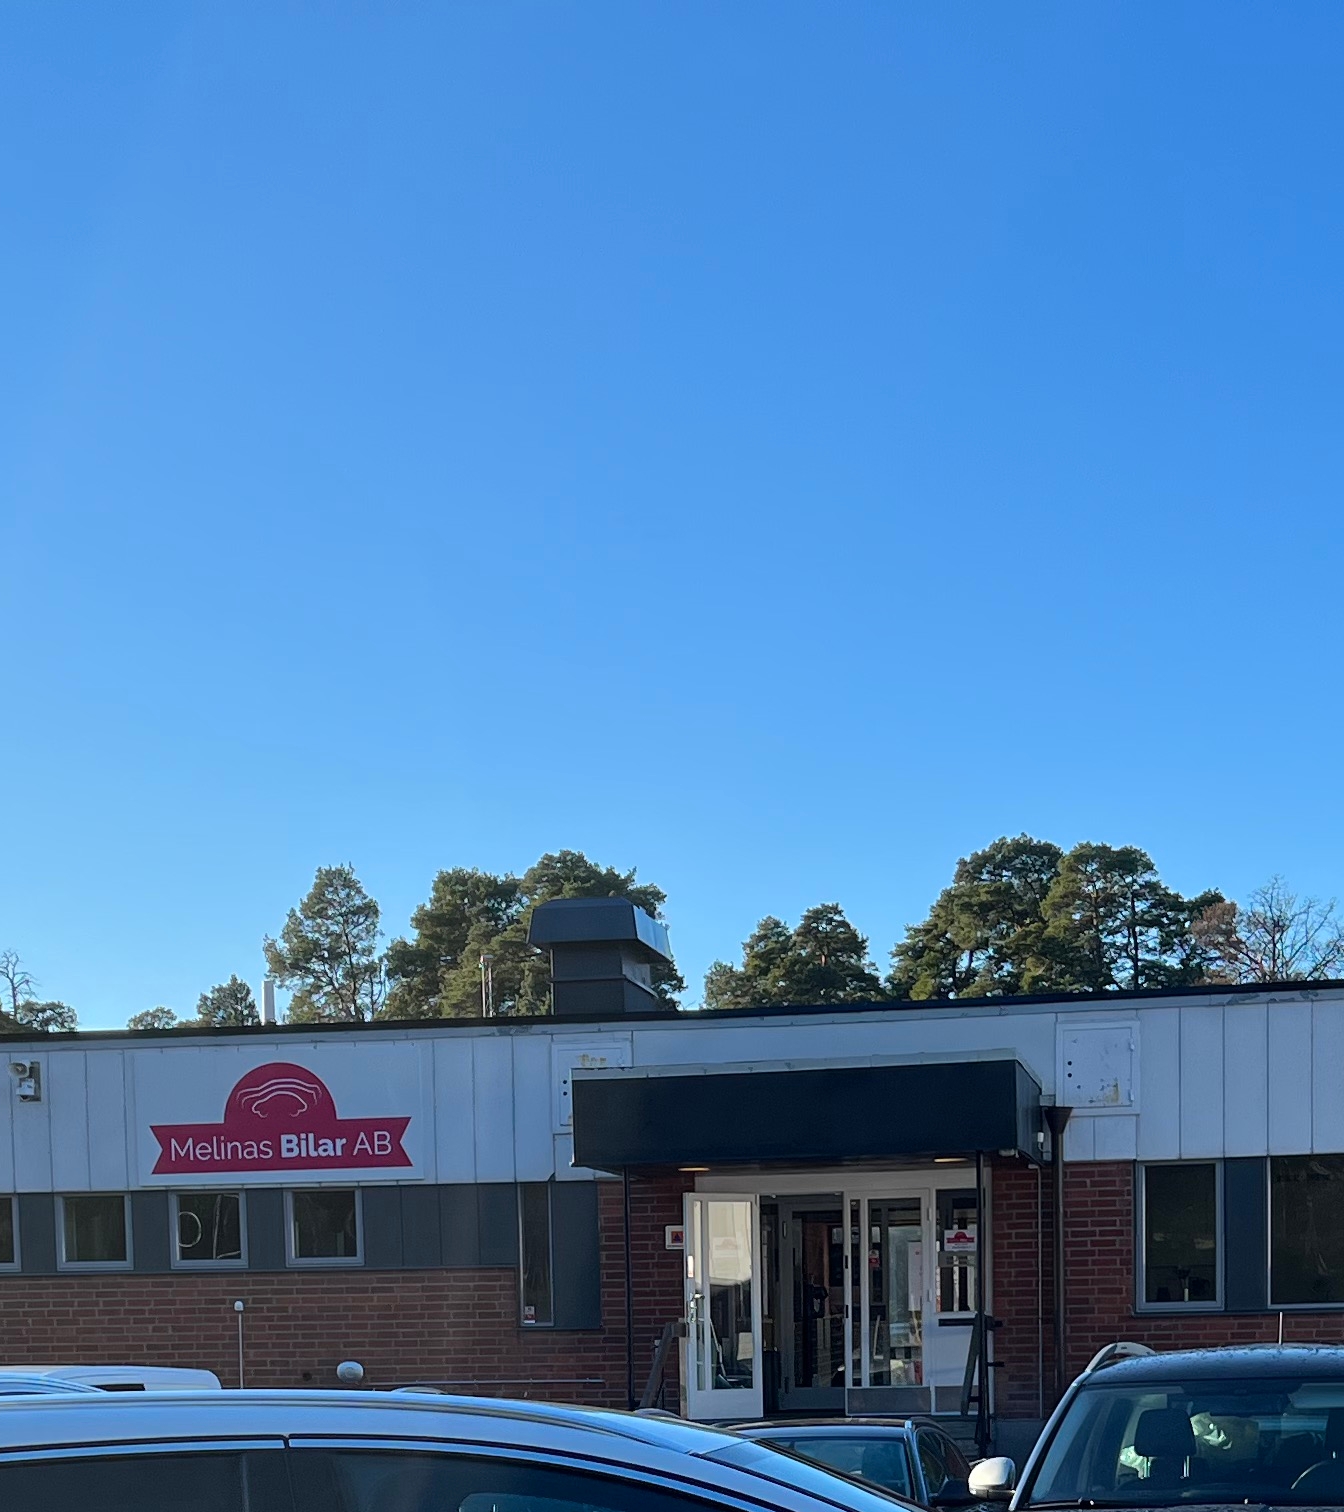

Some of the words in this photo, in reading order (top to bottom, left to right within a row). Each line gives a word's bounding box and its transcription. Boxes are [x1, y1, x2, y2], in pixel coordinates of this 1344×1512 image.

[170, 1136, 273, 1162] Melinas
[281, 1133, 346, 1158] Bilar
[352, 1131, 391, 1156] AB
